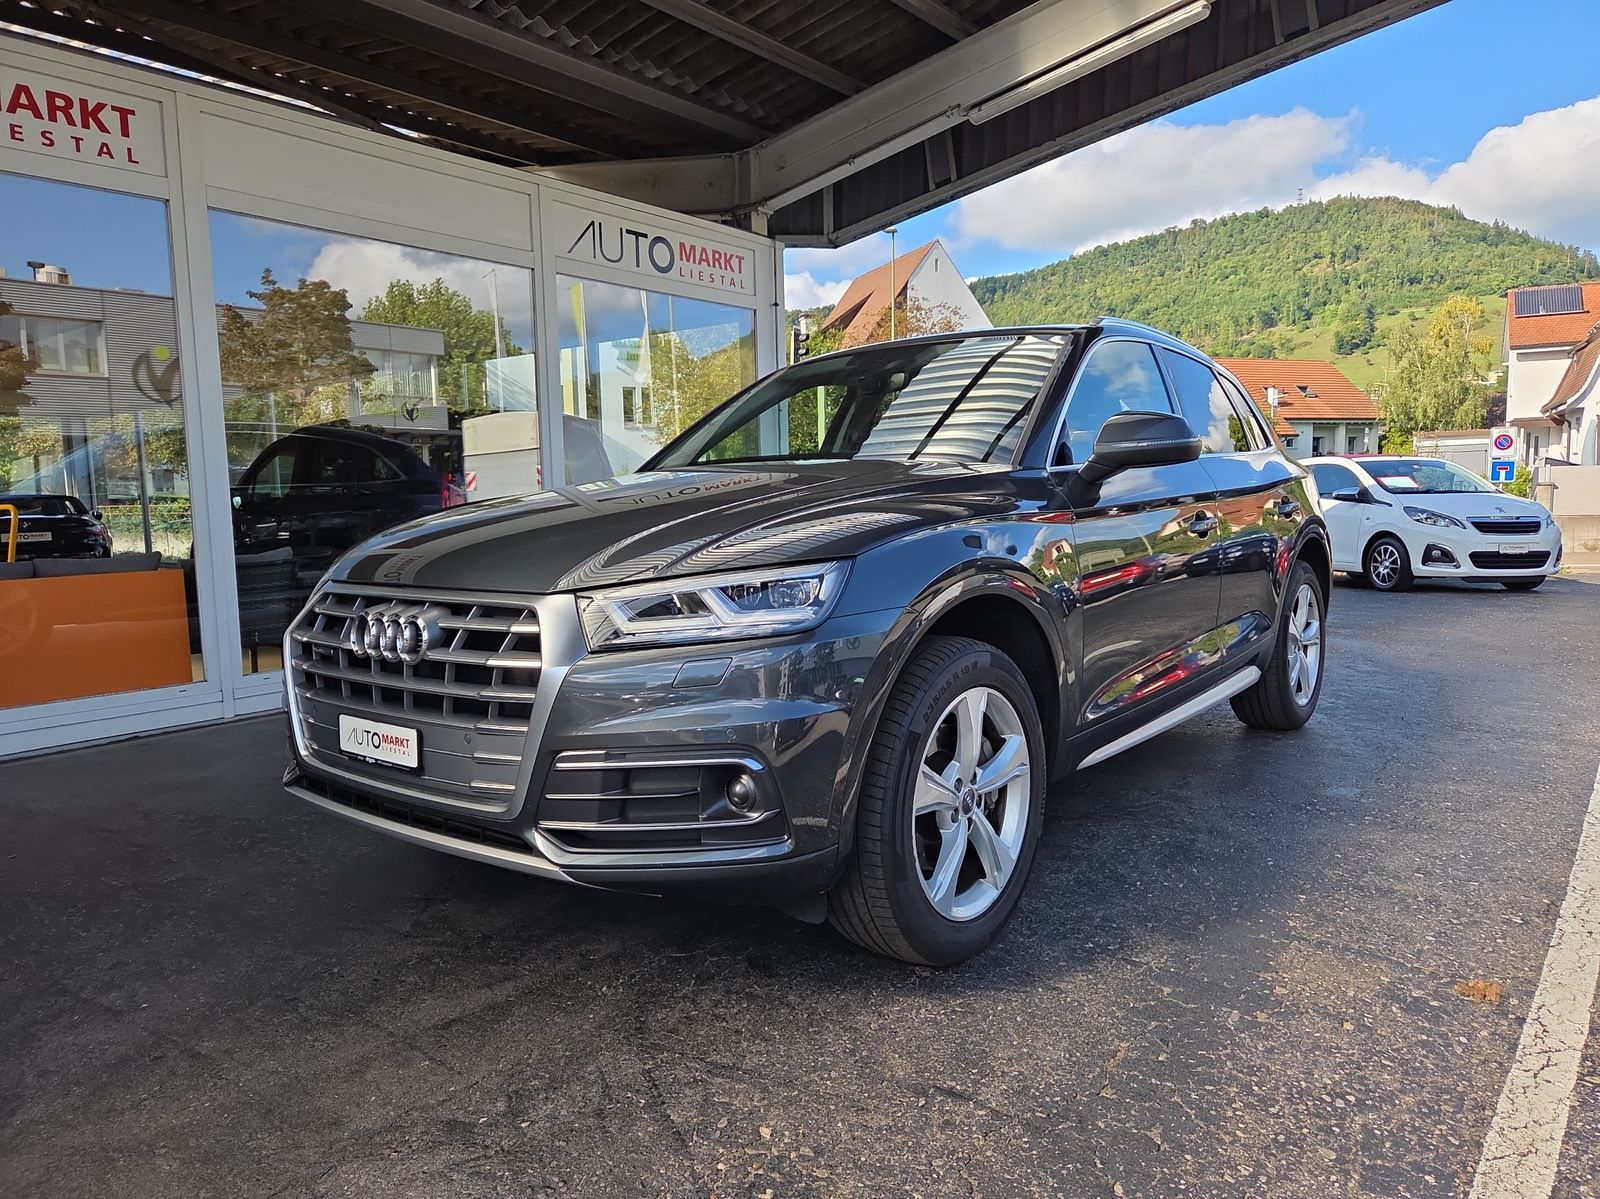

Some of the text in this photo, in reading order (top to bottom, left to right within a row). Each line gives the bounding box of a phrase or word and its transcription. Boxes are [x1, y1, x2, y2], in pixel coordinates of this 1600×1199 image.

[0, 83, 136, 139] ARKT
[567, 220, 745, 274] AUTO MARKT
[679, 266, 745, 289] LIESTAL
[923, 678, 952, 723] 235/55
[961, 665, 970, 675] 19
[347, 727, 410, 749] AUTO MARKT
[381, 746, 411, 757] LIESTAL
